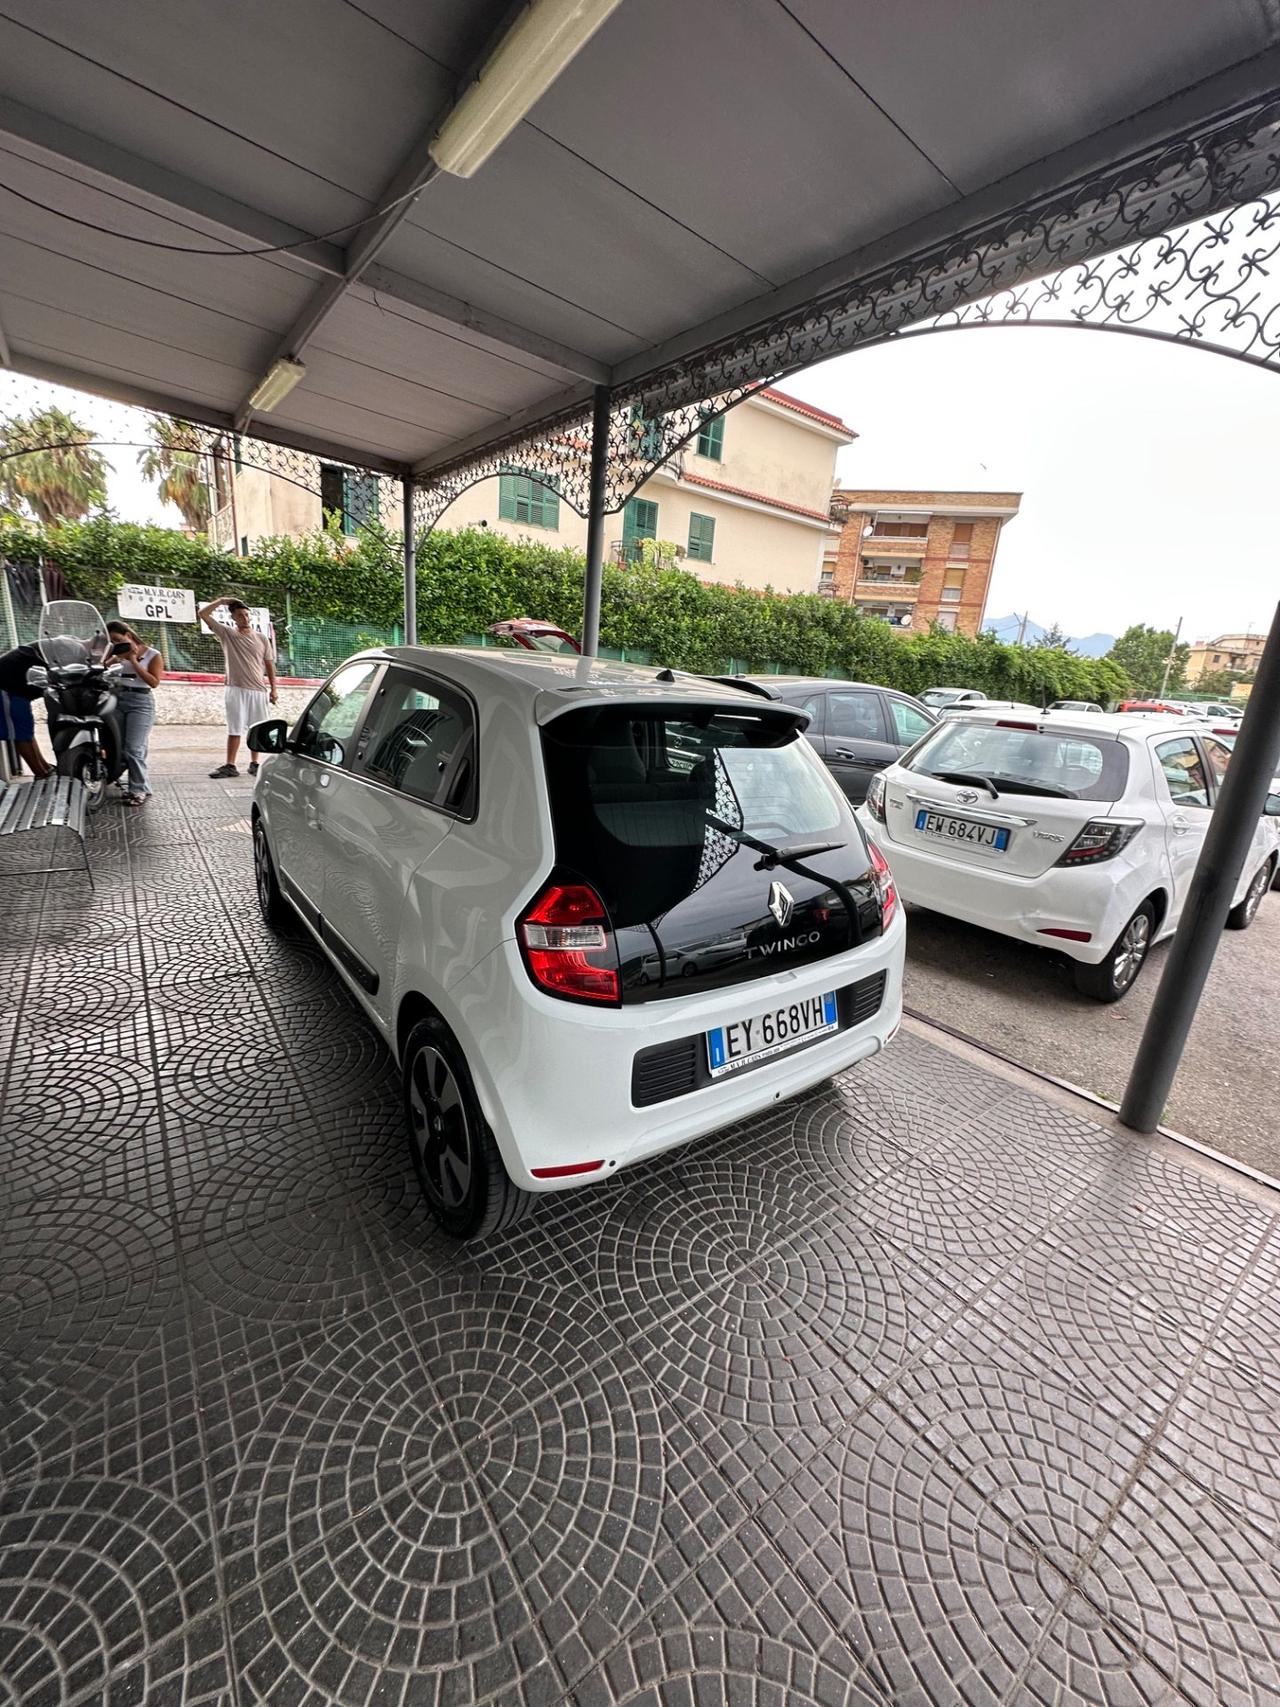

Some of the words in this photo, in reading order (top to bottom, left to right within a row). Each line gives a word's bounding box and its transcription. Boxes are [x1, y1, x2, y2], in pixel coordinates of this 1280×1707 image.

[145, 604, 172, 618] GPL
[926, 815, 944, 832] EW
[948, 820, 996, 845] 684VJ
[743, 931, 820, 959] TWINGO
[726, 1019, 753, 1058] EY
[762, 996, 824, 1044] 668VH
